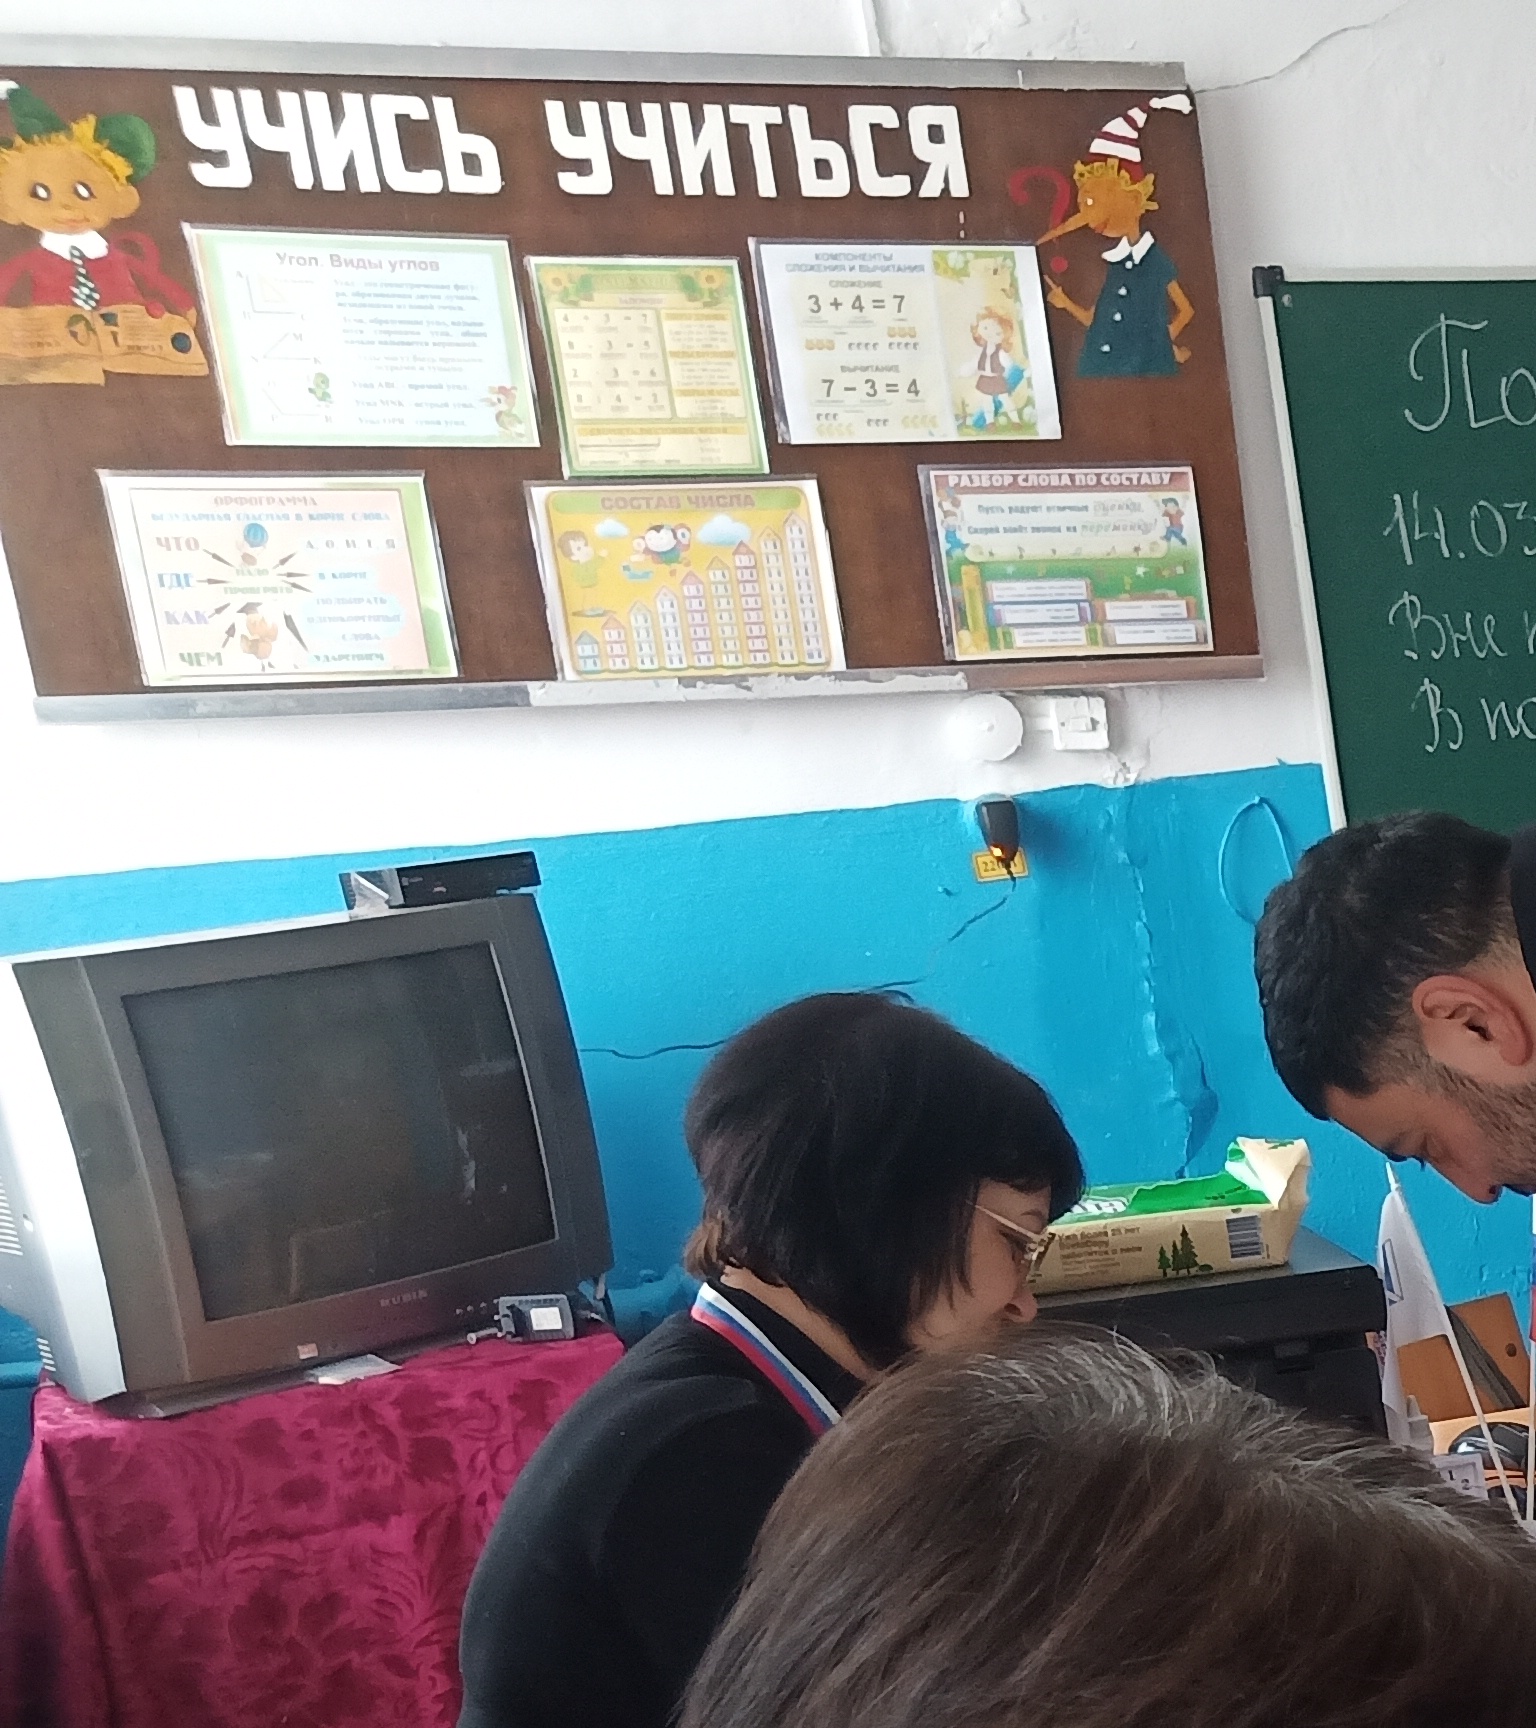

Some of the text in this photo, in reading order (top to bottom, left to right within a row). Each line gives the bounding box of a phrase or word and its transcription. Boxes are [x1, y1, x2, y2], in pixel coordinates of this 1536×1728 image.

[172, 85, 970, 198] УЧИСЬ УЧИТЬСЯ
[329, 253, 383, 270] Виды
[388, 259, 440, 273] углов
[807, 294, 822, 314] 3
[851, 294, 865, 313] 4
[892, 294, 906, 314] 7
[821, 378, 835, 397] 7
[864, 378, 878, 397] 3
[907, 377, 920, 397] 4
[949, 472, 1171, 488] РАЗБОР СЛОВА ПО СОСТАВУ
[601, 493, 755, 511] СОСТАВ ЧИСЛА
[156, 535, 200, 552] ЧТО
[157, 573, 194, 588] ГДЕ
[164, 610, 209, 626] КАК
[1388, 590, 1507, 660] Вне
[178, 651, 223, 667] ЧЕМ
[1413, 678, 1464, 752] В
